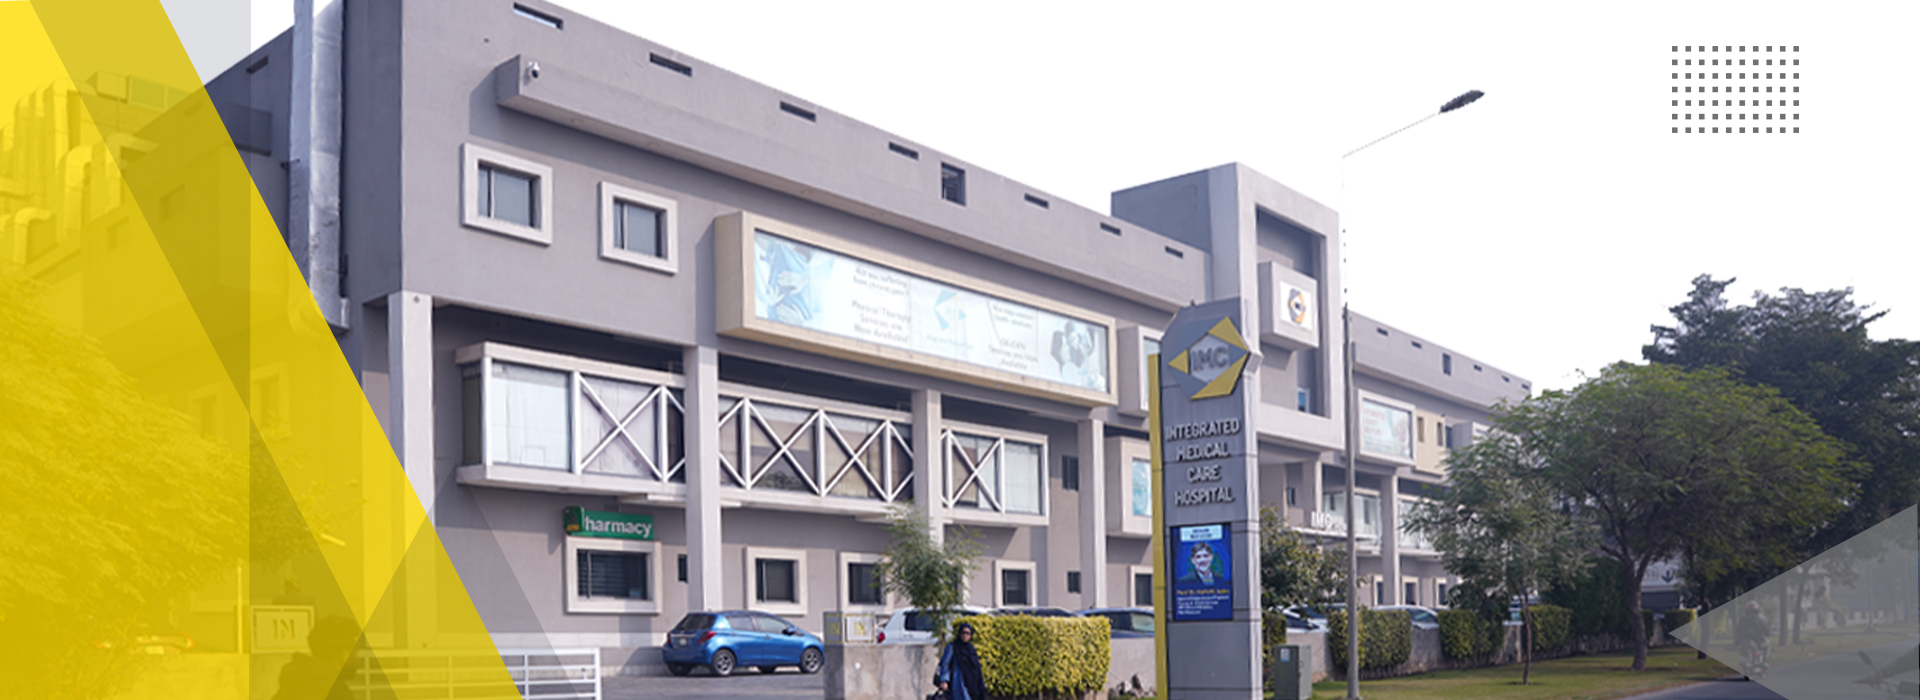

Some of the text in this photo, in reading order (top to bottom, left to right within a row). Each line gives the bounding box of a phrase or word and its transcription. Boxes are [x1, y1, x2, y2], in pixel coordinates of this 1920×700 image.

[1190, 346, 1229, 372] IMC
[1166, 417, 1241, 442] INTEGRATED
[1176, 442, 1231, 462] MEDICAL
[1186, 465, 1222, 484] CARE
[1174, 487, 1236, 507] HOSPITAL
[584, 515, 652, 539] harmacy
[273, 619, 295, 640] IN
[853, 621, 866, 636] IN
